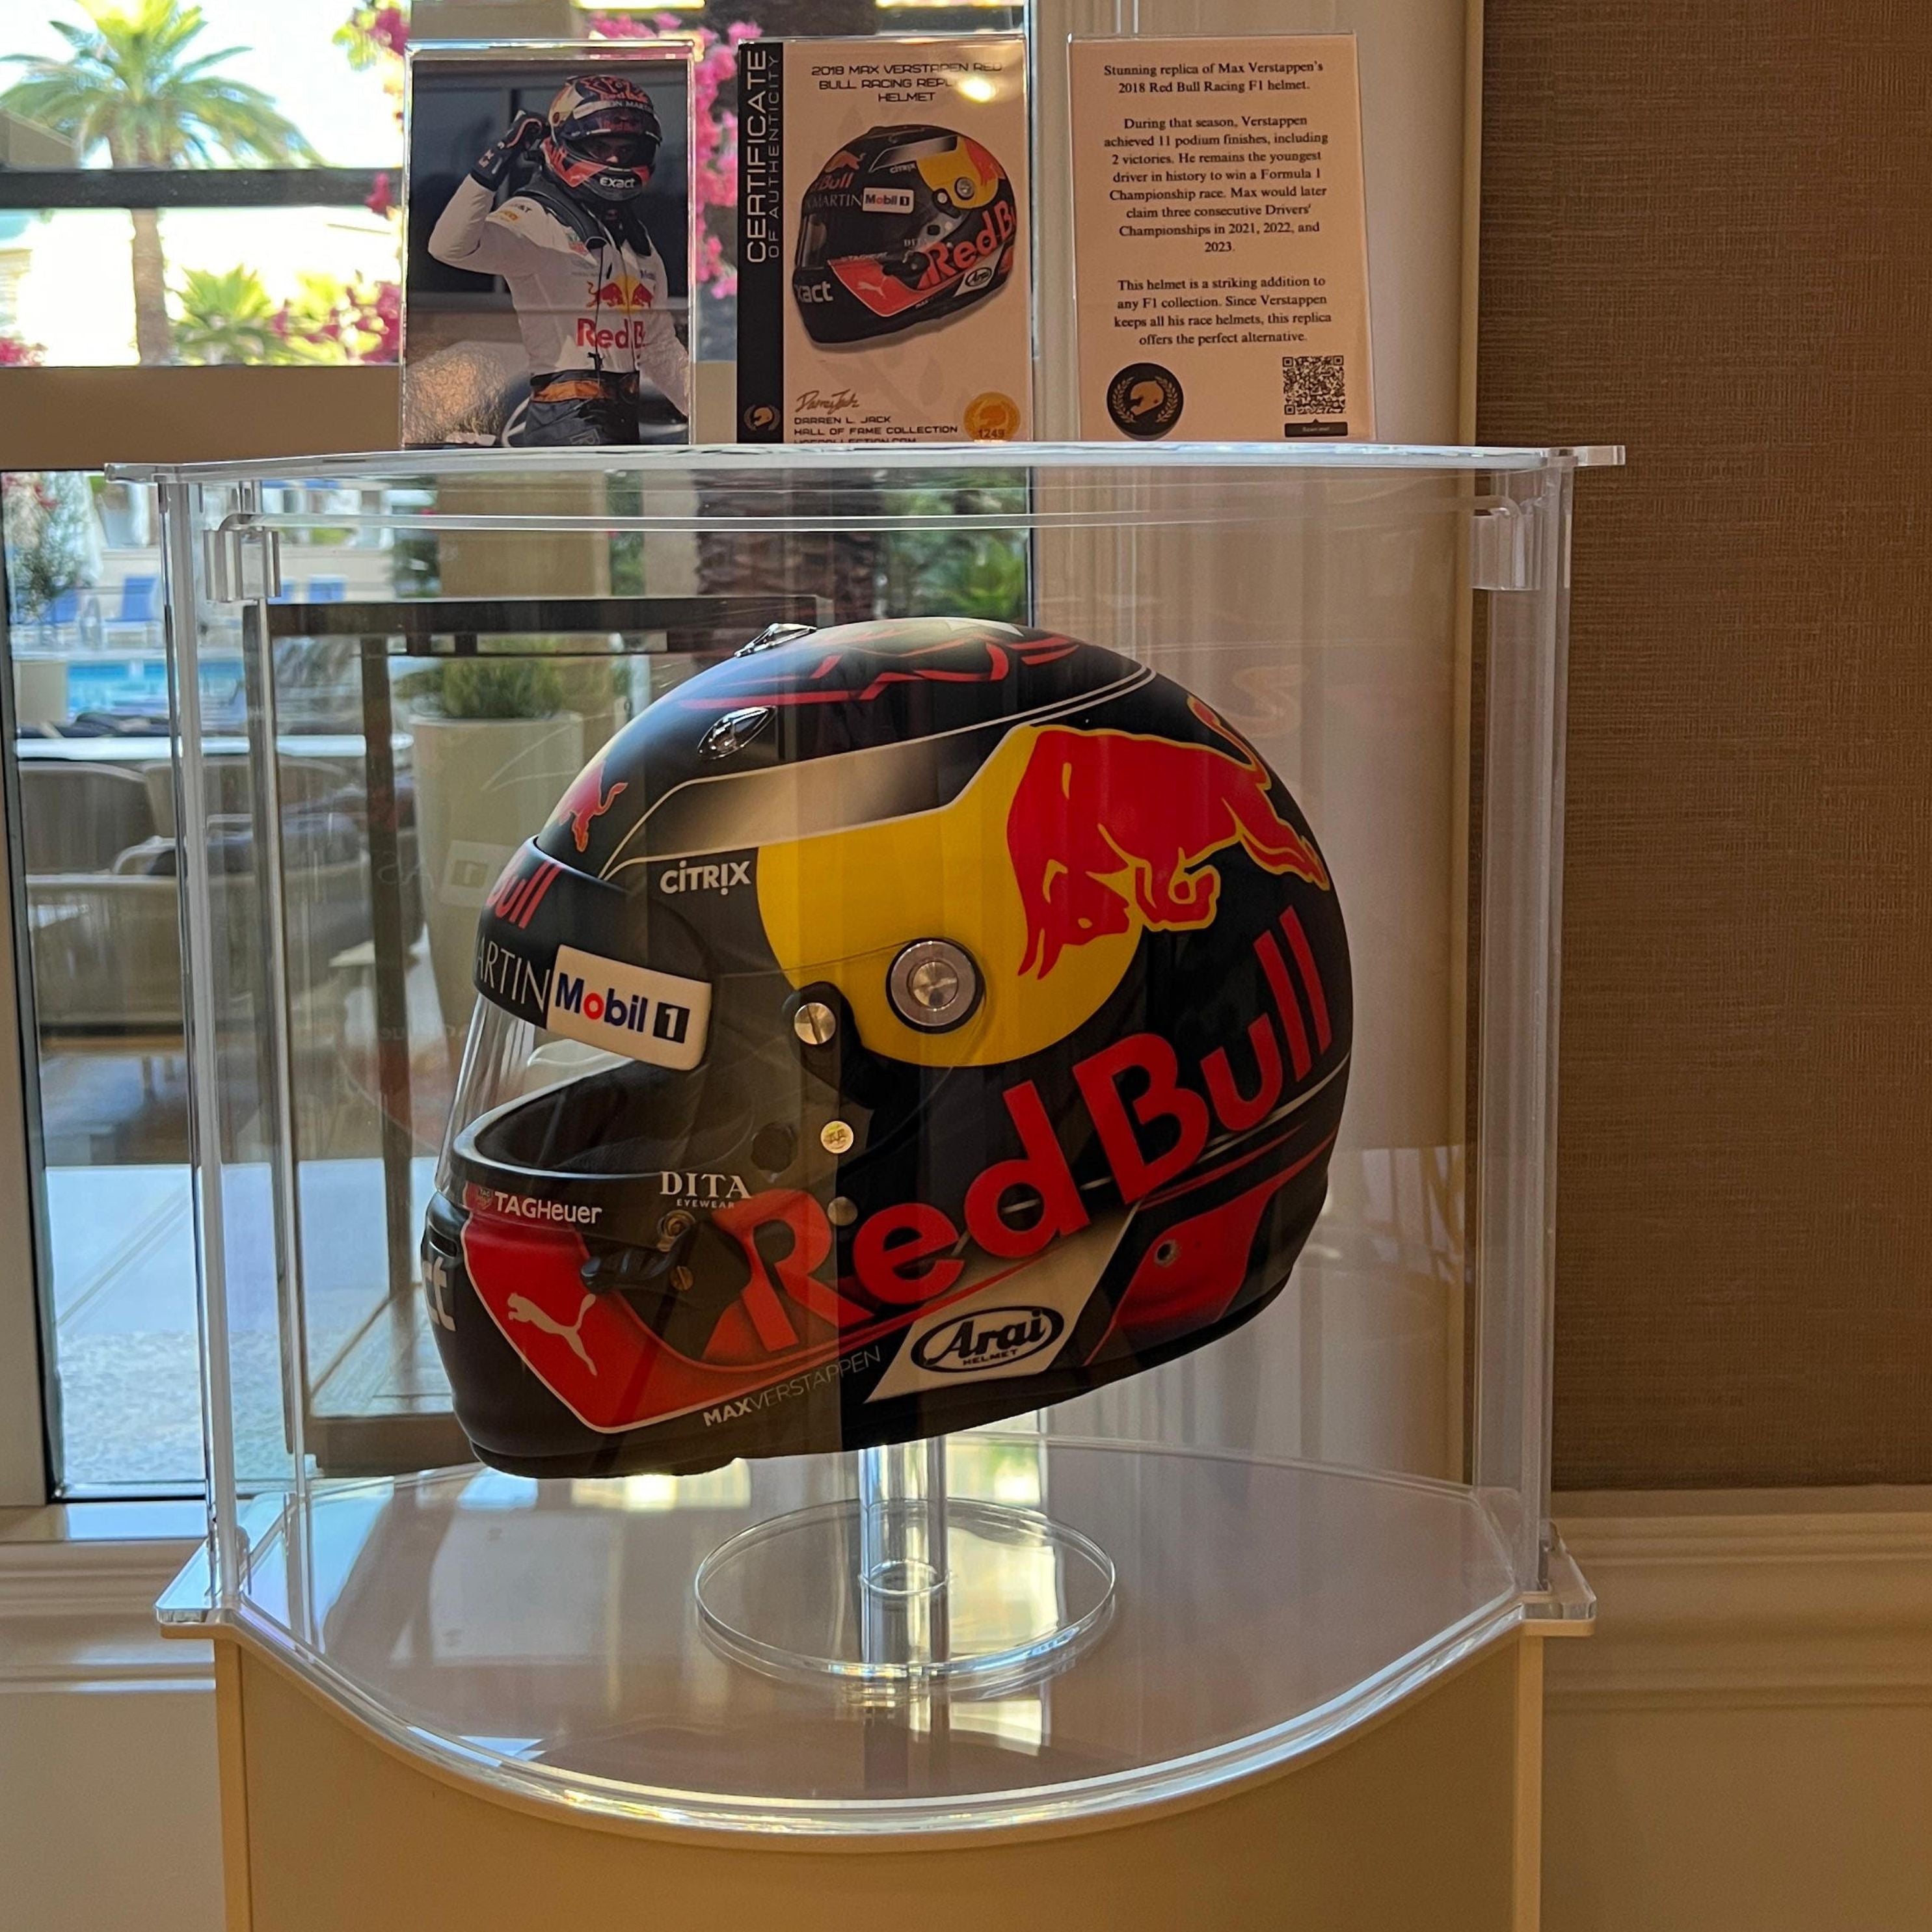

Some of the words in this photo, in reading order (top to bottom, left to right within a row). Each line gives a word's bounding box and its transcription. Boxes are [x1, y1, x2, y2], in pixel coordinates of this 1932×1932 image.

[812, 66, 844, 76] 2018
[849, 64, 879, 75] MAX
[973, 62, 1002, 72] RED
[1103, 64, 1157, 77] Stunning
[1160, 63, 1198, 77] replica
[1201, 62, 1215, 74] of
[1218, 62, 1245, 73] Max
[1248, 60, 1323, 74] Verstappen's
[818, 80, 857, 90] BULL
[861, 78, 912, 88] RACING
[1118, 82, 1145, 93] 2018
[1149, 81, 1173, 92] Red
[1177, 81, 1200, 92] Bull
[1203, 81, 1245, 93] Racing
[1248, 79, 1262, 90] F1
[1267, 79, 1309, 90] helmet.
[878, 92, 935, 102] HELMET
[1123, 118, 1166, 131] During
[1169, 117, 1192, 127] that
[1195, 119, 1238, 127] season,
[1241, 115, 1307, 128] Verstappen
[768, 55, 780, 219] AUTHENTICITY
[1104, 135, 1154, 147] achieved
[1159, 135, 1170, 146] 11
[1174, 135, 1220, 148] podium
[1223, 133, 1270, 145] finishes,
[1274, 131, 1328, 144] including
[747, 50, 766, 263] CERTIFICATE
[1112, 154, 1118, 165] 2
[1122, 155, 1174, 165] victories.
[1178, 152, 1196, 163] He
[1198, 154, 1244, 163] remains
[1248, 151, 1266, 161] the
[1269, 151, 1321, 164] youngest
[600, 177, 636, 189] exact
[1112, 172, 1148, 183] driver
[1151, 171, 1162, 181] in
[1165, 170, 1206, 183] history
[1210, 171, 1222, 180] to
[1225, 169, 1246, 180] win
[1260, 168, 1311, 180] Formula
[1316, 167, 1320, 178] 1
[865, 195, 897, 205] Mobil
[1109, 188, 1196, 202] Championship
[1198, 190, 1226, 198] race.
[1230, 187, 1257, 198] Max
[1260, 185, 1296, 196] would
[1300, 185, 1327, 196] later
[1125, 207, 1158, 218] claim
[1161, 206, 1191, 217] three
[1194, 205, 1261, 217] consecutive
[1265, 203, 1311, 215] Drivers'
[1119, 224, 1211, 238] Championships
[1214, 223, 1225, 234] in
[1228, 222, 1259, 234] 2021,
[1263, 221, 1295, 234] 2022,
[1298, 221, 1319, 232] and
[768, 230, 780, 258] OF
[1204, 241, 1235, 252] 2023.
[1117, 279, 1144, 291] This
[1146, 278, 1186, 290] helmet
[1189, 278, 1199, 289] is
[1212, 276, 1257, 290] striking
[1260, 276, 1310, 287] addition
[1313, 277, 1326, 286] to
[1117, 301, 1138, 311] any
[1142, 297, 1157, 308] F1
[1161, 296, 1222, 308] collection.
[1225, 295, 1257, 306] Since
[1259, 294, 1327, 307] Verstappen
[1114, 315, 1147, 329] keeps
[1149, 315, 1164, 327] all
[1167, 315, 1185, 326] his
[1188, 317, 1213, 326] race
[1215, 314, 1264, 325] helmets,
[1267, 312, 1289, 323] this
[1292, 312, 1332, 325] replica
[576, 317, 630, 349] Red
[1138, 334, 1173, 345] offers
[1176, 333, 1194, 344] the
[1198, 332, 1239, 346] perfect
[1241, 331, 1306, 343] alternative.
[850, 427, 882, 435] FAME
[886, 425, 958, 434] COLLECTION
[487, 859, 563, 929] ull
[477, 935, 551, 1013] ARTIN
[555, 972, 649, 1033] Mobil
[713, 1080, 1092, 1350] Red
[1073, 906, 1332, 1204] Bull
[659, 1170, 753, 1200] DITA
[677, 1198, 735, 1209] EYEWEAR
[925, 1308, 1047, 1366] Arai
[963, 1348, 1019, 1366] HELMET
